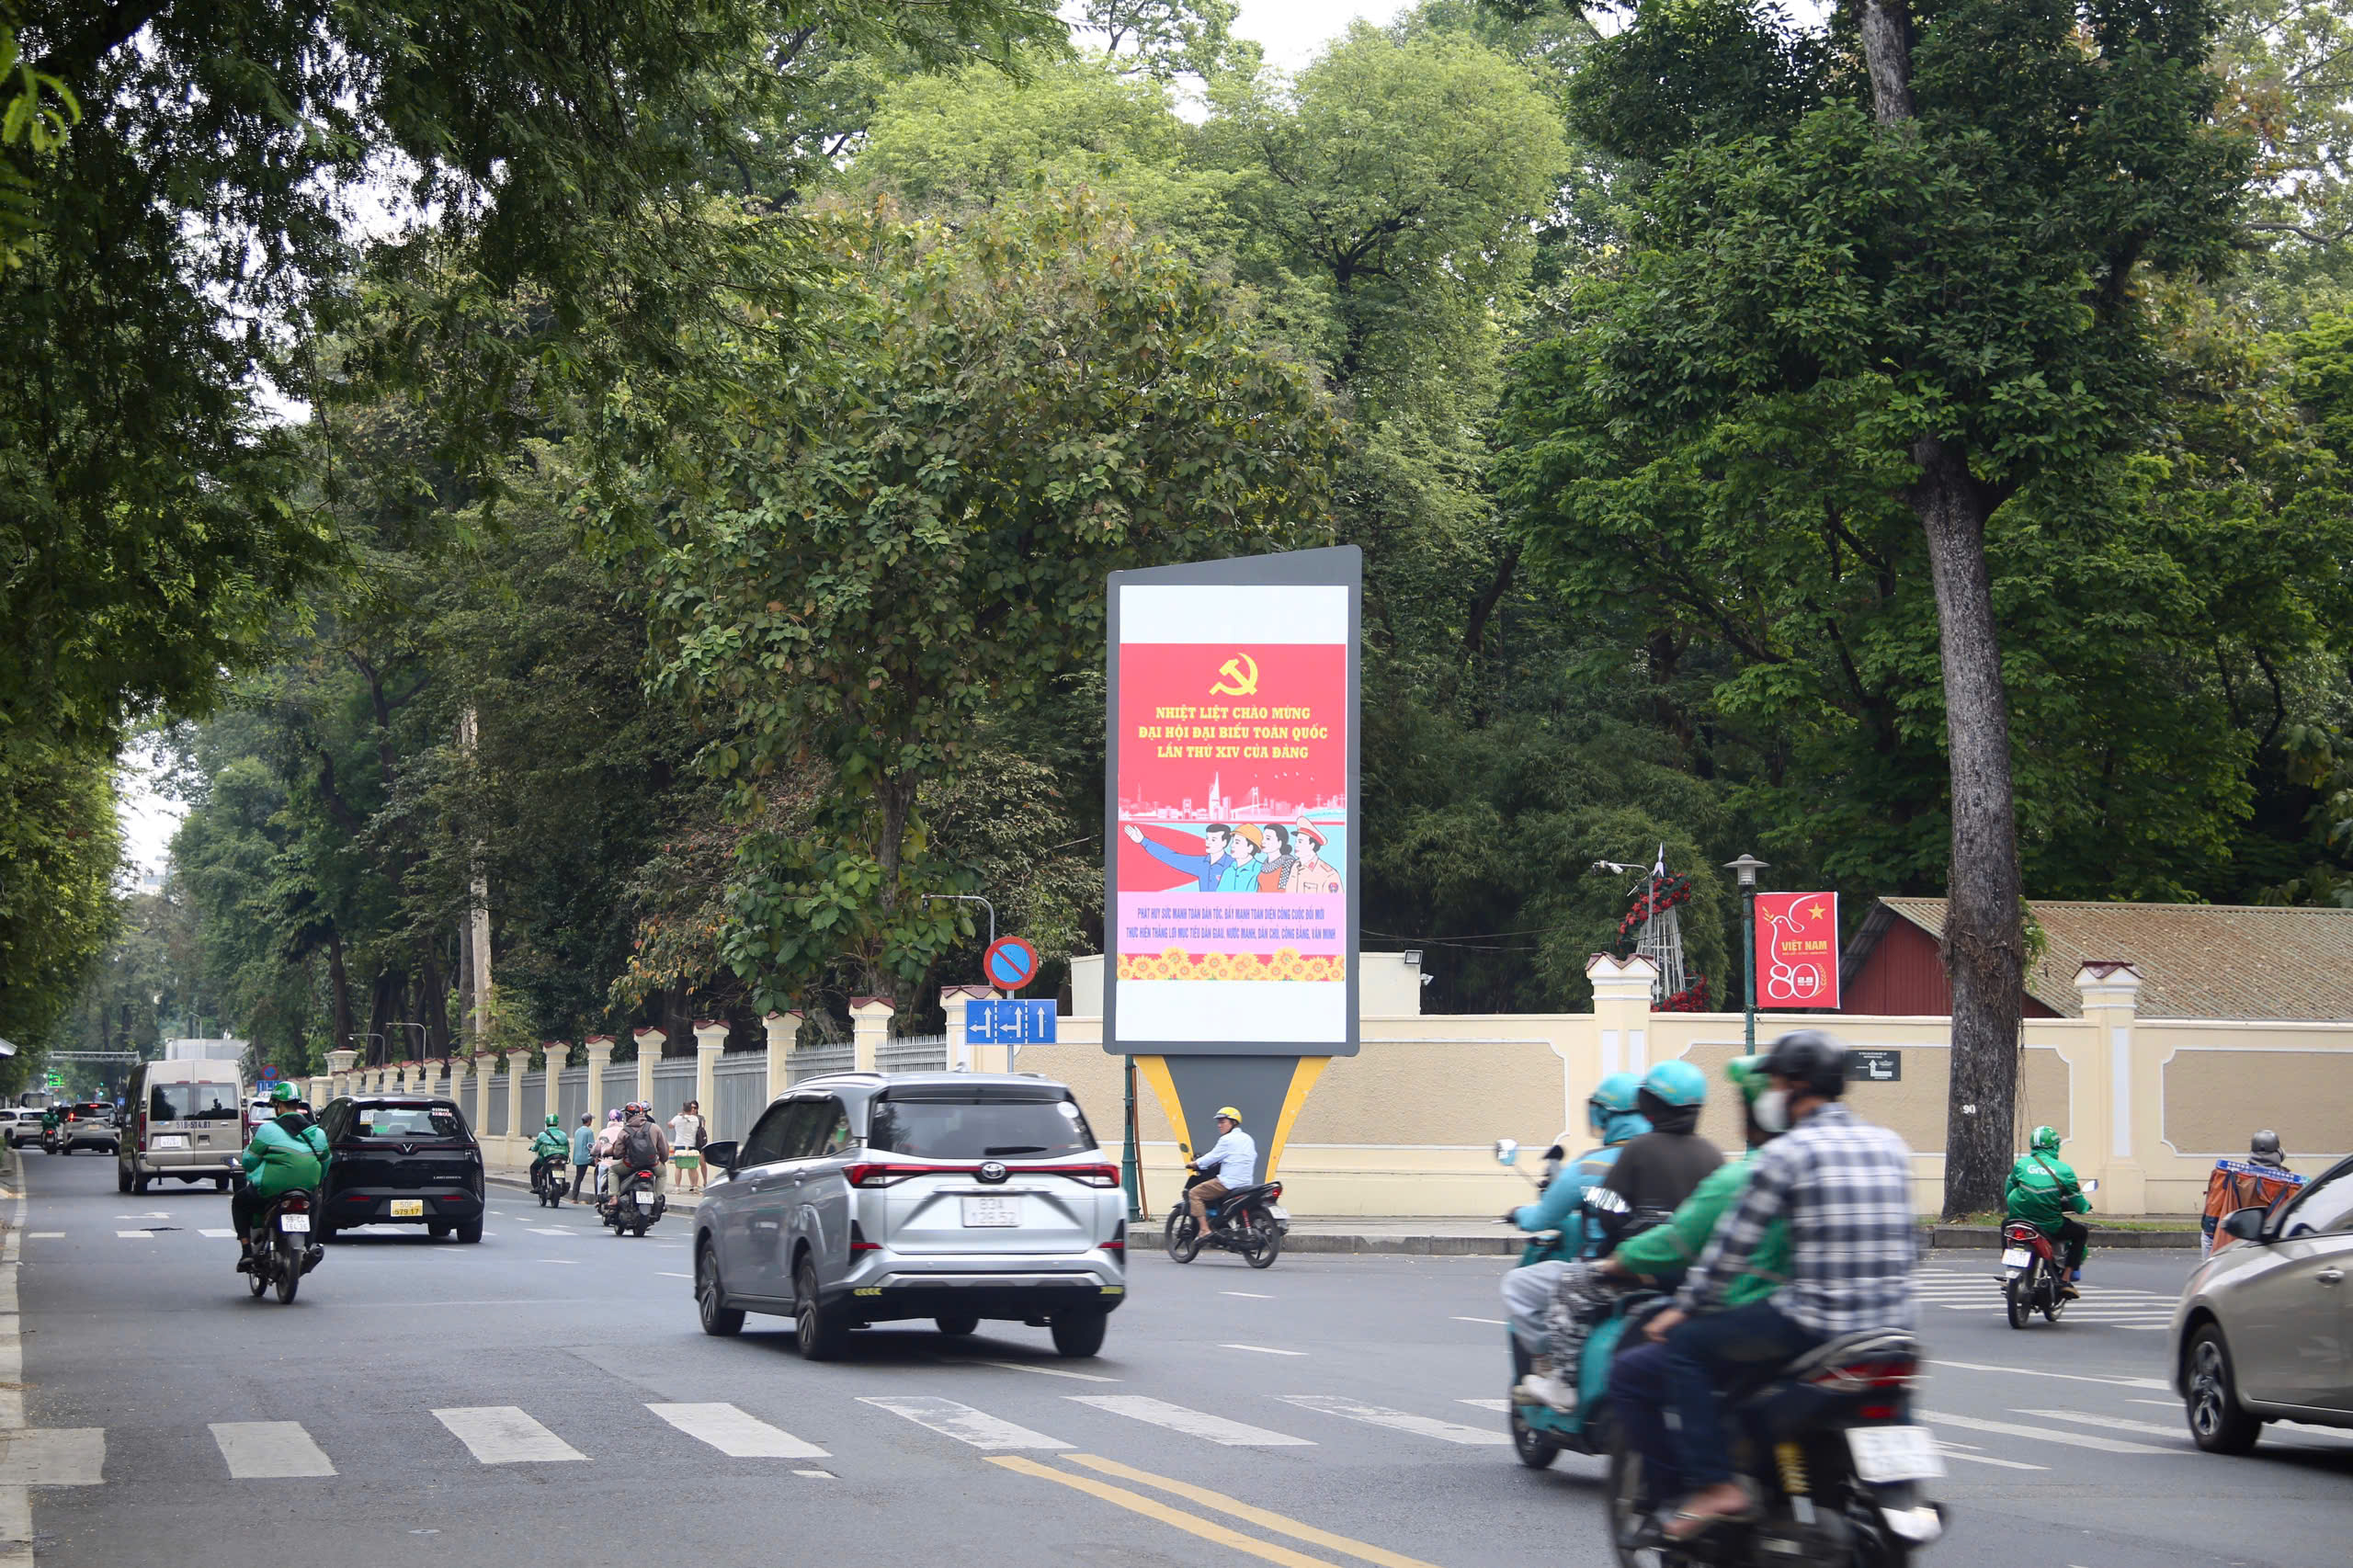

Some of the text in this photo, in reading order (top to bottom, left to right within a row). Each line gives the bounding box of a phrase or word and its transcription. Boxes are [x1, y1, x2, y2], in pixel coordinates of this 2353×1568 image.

[1156, 704, 1311, 721] NHIỆT LIỆT CHÀO MỪNG
[1139, 722, 1327, 742] ĐẠI HỘI ĐẠI BIỂU TOÀN QUỐC
[1157, 741, 1309, 758] LẦN THỨ XIV CỦA ĐẢNG
[1781, 939, 1827, 951] VIỆT NAM
[1768, 963, 1819, 999] 80
[1963, 1105, 1975, 1114] 90
